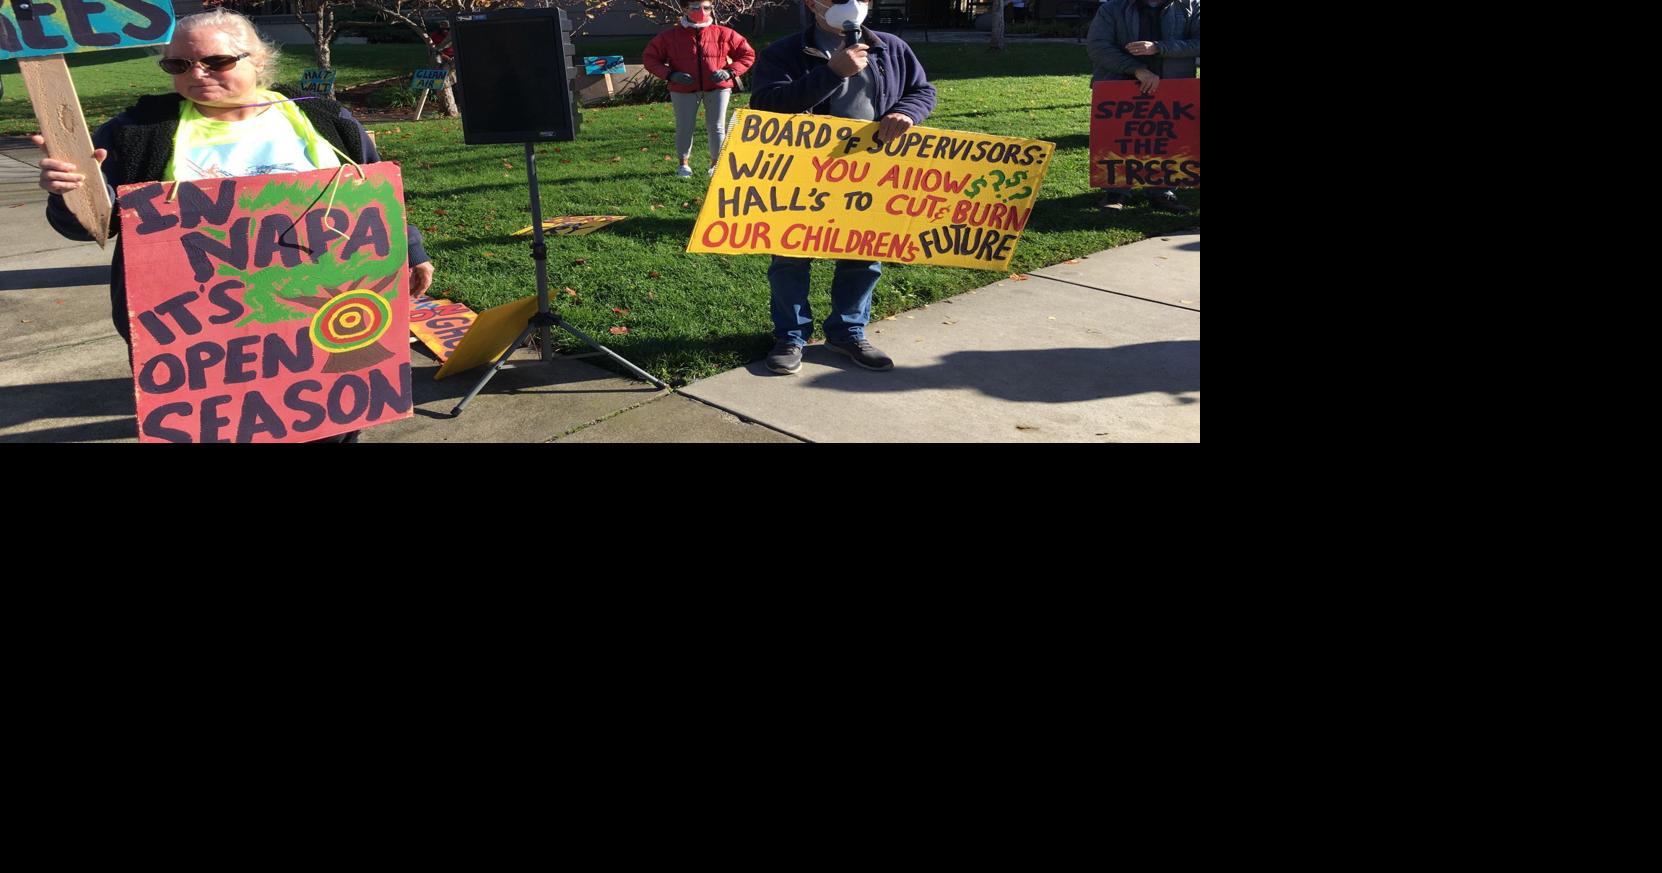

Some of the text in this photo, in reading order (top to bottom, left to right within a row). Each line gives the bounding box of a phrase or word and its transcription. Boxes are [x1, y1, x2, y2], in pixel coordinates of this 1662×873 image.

[416, 70, 447, 79] CLEAN
[1095, 101, 1196, 121] SPEAK
[741, 114, 832, 149] BOARD
[1114, 138, 1169, 155] THE
[1124, 121, 1178, 139] FOR
[812, 156, 870, 183] YOU
[1097, 159, 1200, 186] TREES
[119, 180, 236, 235] IN
[844, 191, 873, 211] TO
[951, 200, 1031, 231] BURN
[180, 207, 391, 283] NAPA
[702, 221, 771, 249] OUR
[918, 224, 1018, 262] FUTURE
[138, 280, 245, 345] IT'S
[138, 327, 314, 394] OPEN
[143, 363, 412, 443] SEASON
